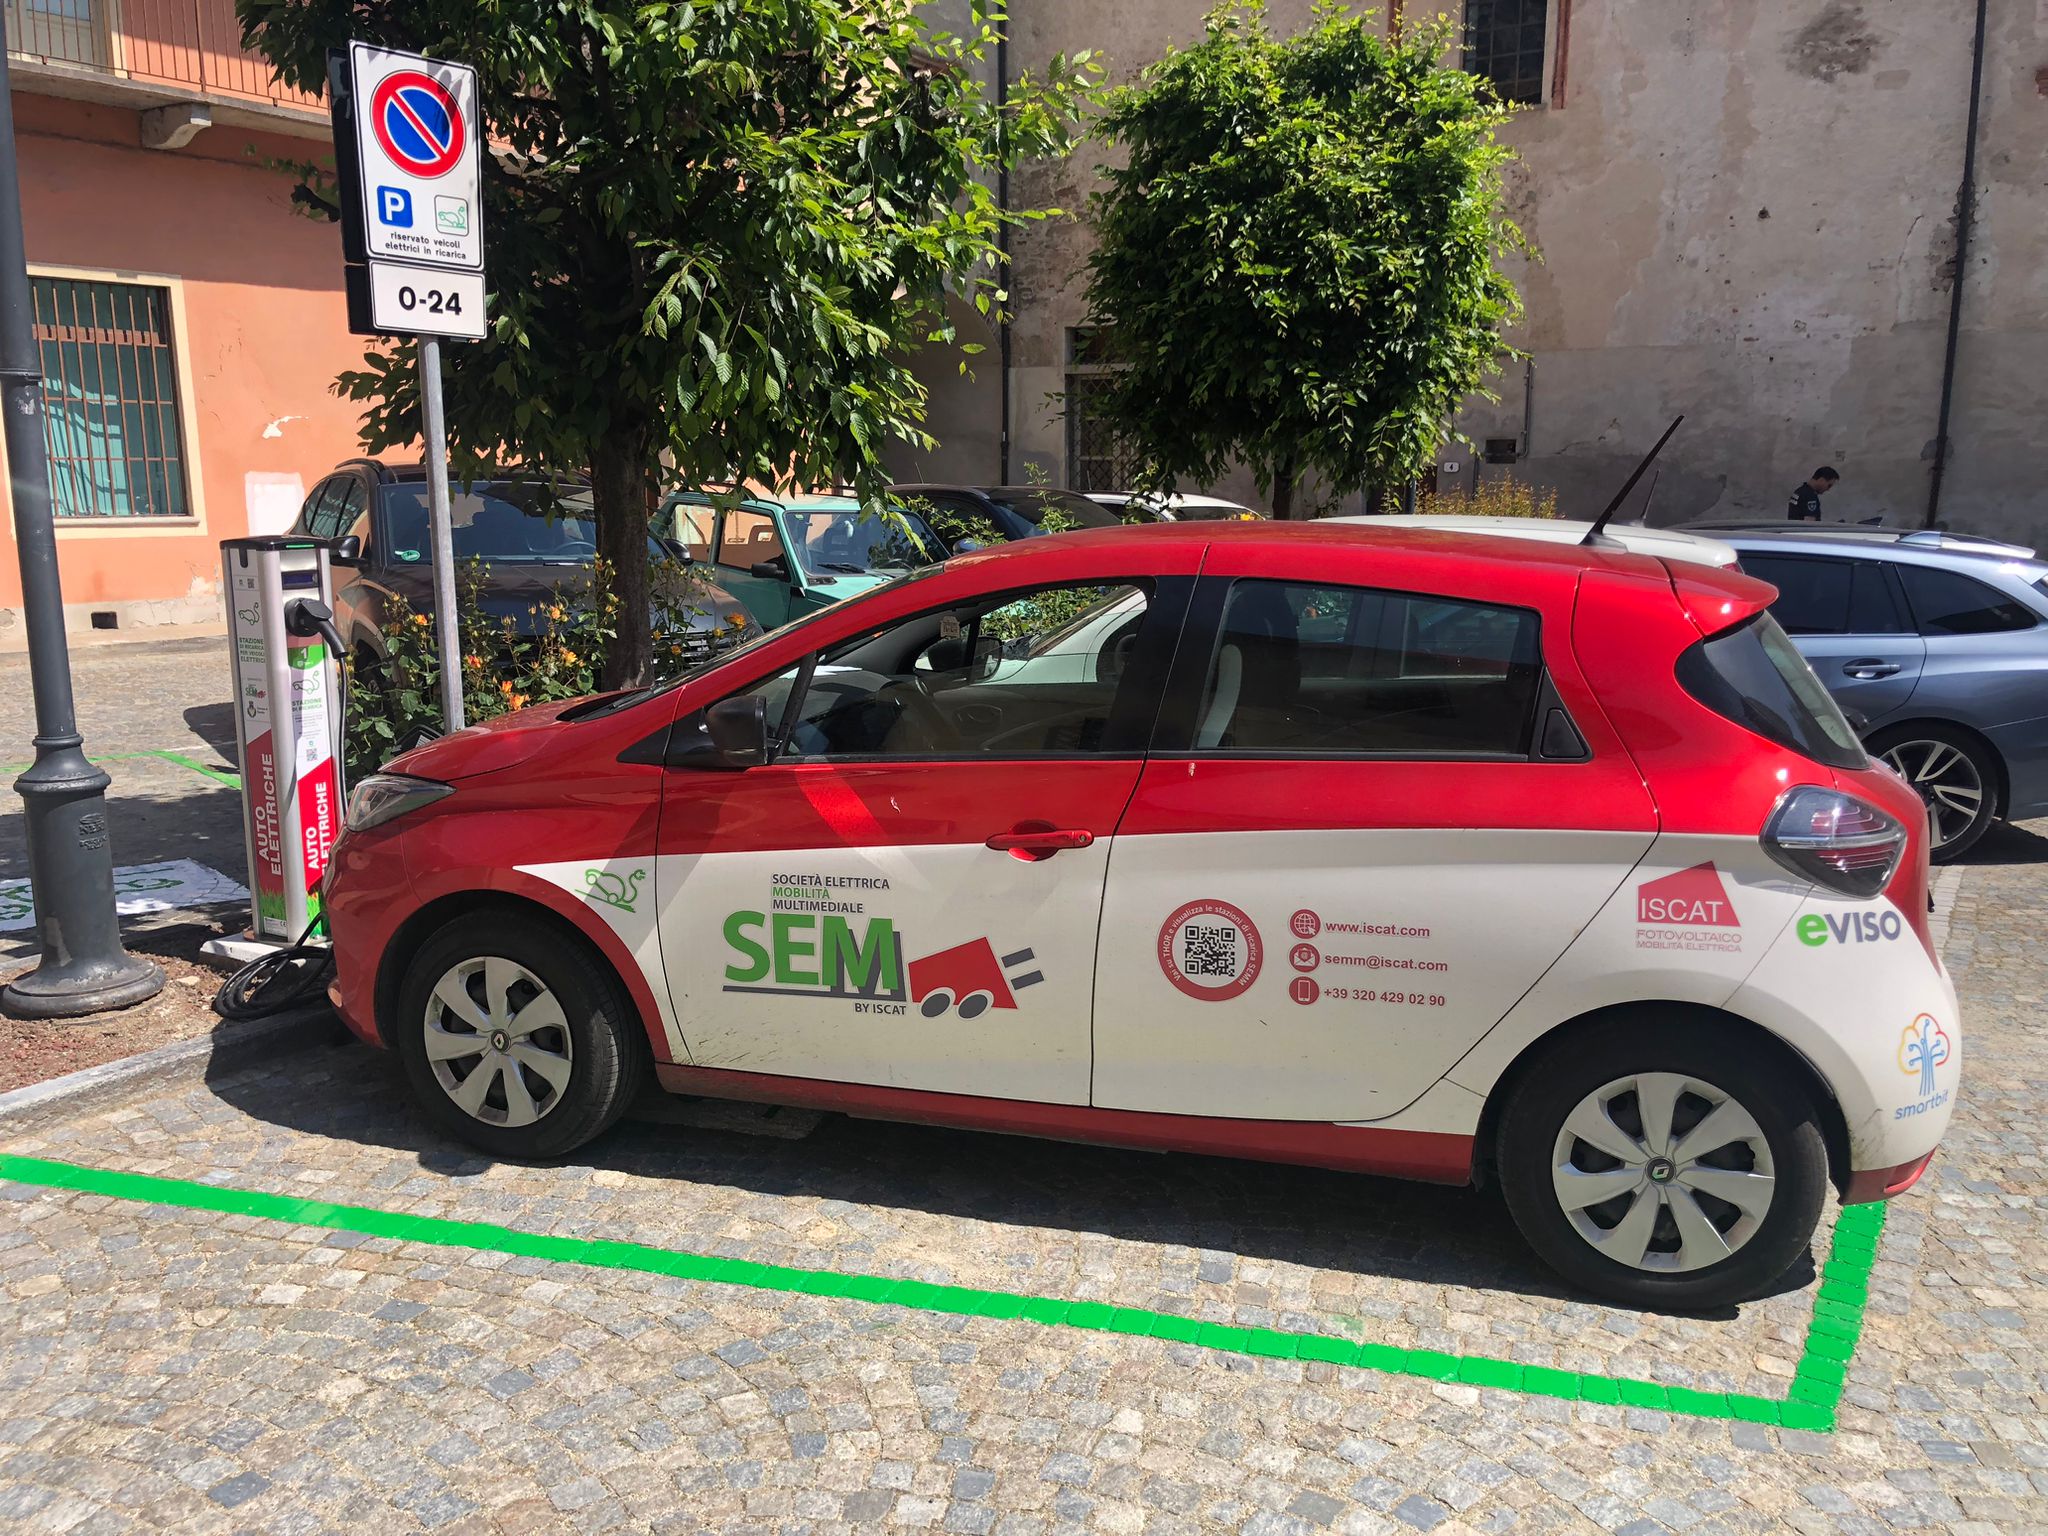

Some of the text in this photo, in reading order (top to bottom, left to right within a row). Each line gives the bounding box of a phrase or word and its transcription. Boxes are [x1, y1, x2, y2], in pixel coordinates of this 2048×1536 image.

[384, 191, 405, 221] P
[390, 232, 460, 248] riservato veicoli
[385, 242, 466, 259] elettrici in ricarica
[398, 286, 462, 315] 0-24
[239, 637, 264, 645] STAZIONE
[301, 648, 307, 658] 1
[261, 753, 282, 876] ELETTRICHE
[255, 805, 269, 861] AUTO
[315, 781, 331, 875] ETTRICHE
[306, 826, 319, 869] AUTO
[772, 874, 890, 889] SOCIETÀ ELETTRICA
[772, 886, 830, 899] MOBILITÀ
[772, 899, 863, 913] MULTIMEDIALE
[1641, 898, 1723, 922] ISCAT
[1171, 906, 1203, 928] visualizza
[1215, 907, 1243, 925] stazioni
[1241, 924, 1249, 932] di
[1325, 922, 1430, 937] www.iscat.com
[1636, 929, 1742, 943] FOTOVOLTAICO
[1163, 934, 1172, 958] THOR
[1246, 933, 1258, 961] ricarica
[1686, 943, 1742, 952] ELETTRICA
[1324, 954, 1448, 971] semm@iscat.com
[1238, 963, 1256, 986] SEMM
[1324, 988, 1445, 1006] +39 320 429 02 90
[855, 1003, 906, 1016] BY ISCAT
